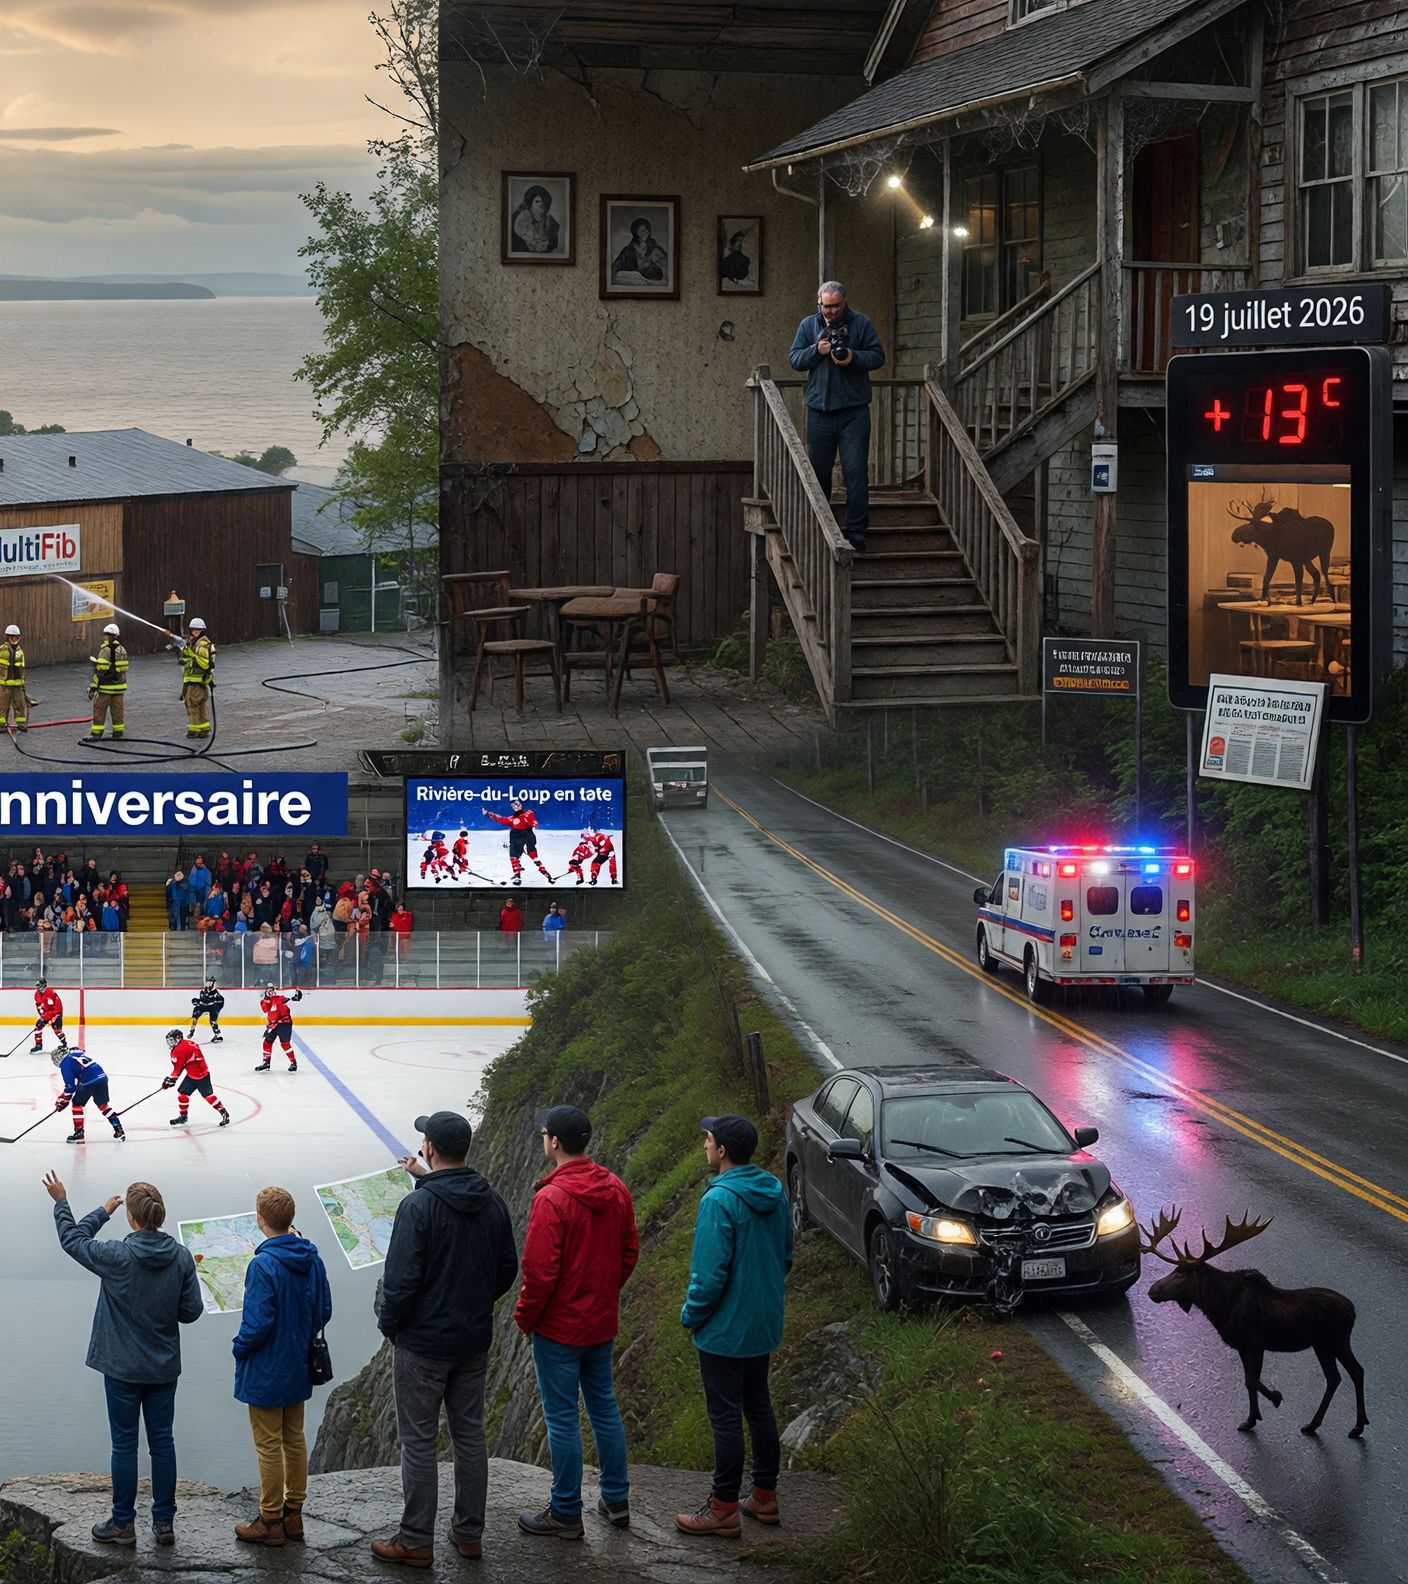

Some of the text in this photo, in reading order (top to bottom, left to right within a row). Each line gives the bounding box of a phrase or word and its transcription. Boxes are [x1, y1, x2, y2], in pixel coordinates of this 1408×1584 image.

[1185, 295, 1366, 340] 19 juillet 2026
[553, 789, 575, 802] en
